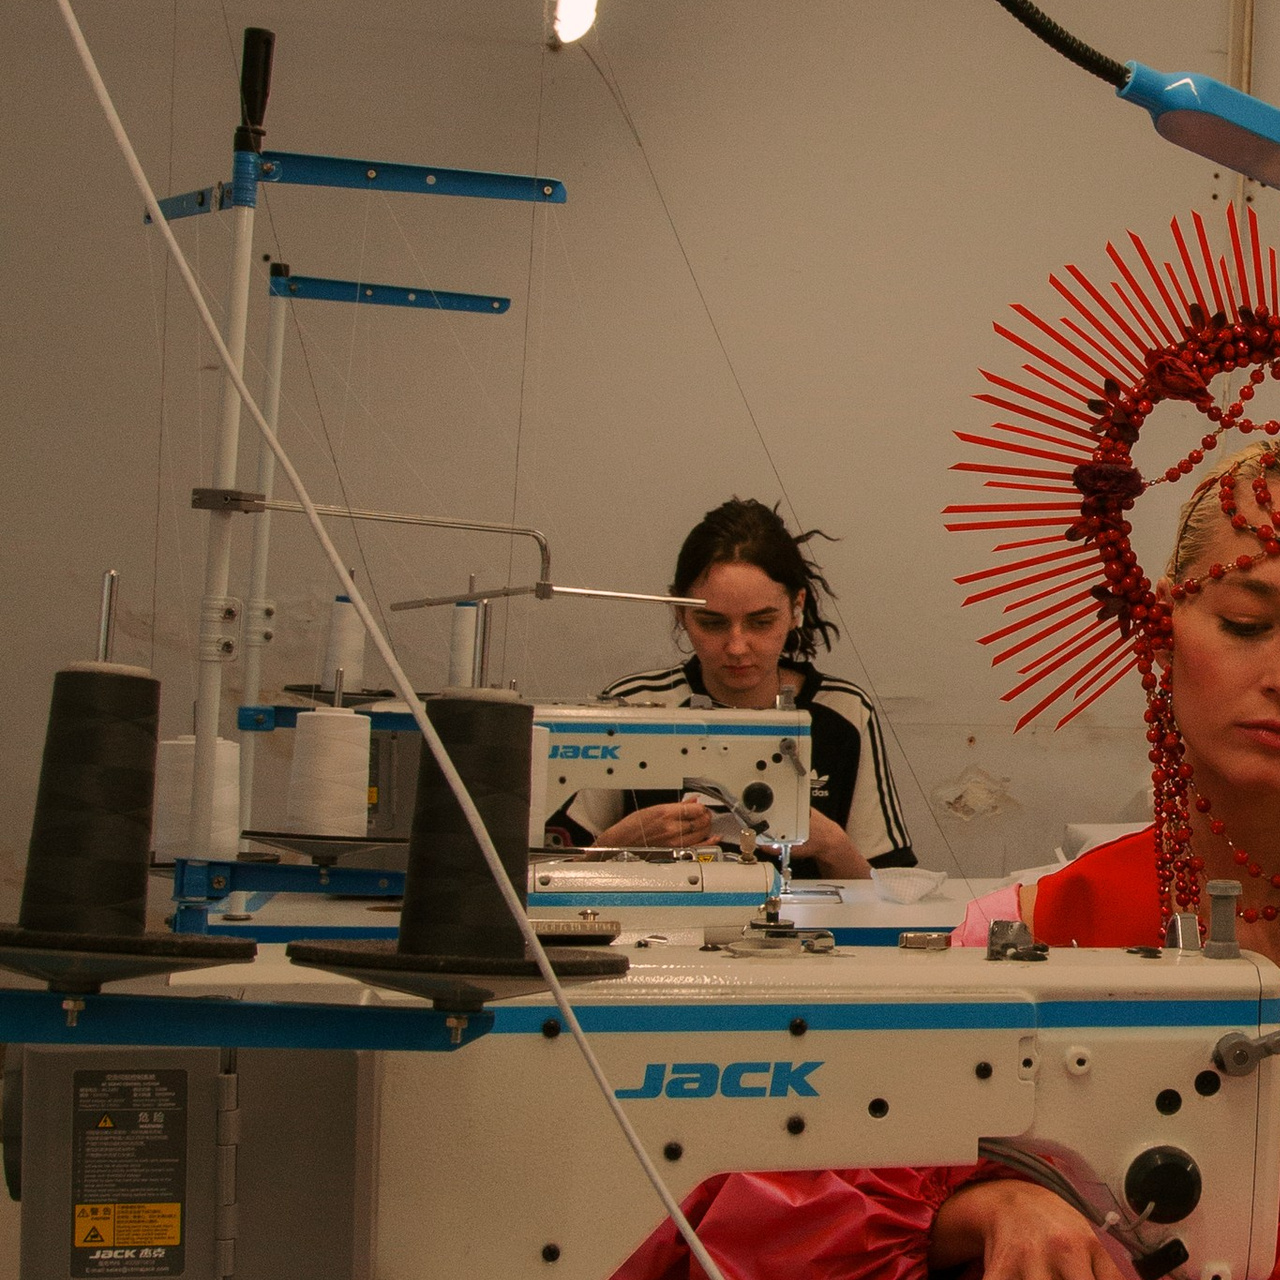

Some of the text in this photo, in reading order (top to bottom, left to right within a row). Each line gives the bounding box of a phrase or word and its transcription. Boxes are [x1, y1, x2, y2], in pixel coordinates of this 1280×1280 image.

[548, 744, 621, 759] JACK
[614, 1061, 825, 1099] JACK
[89, 1249, 137, 1259] JACK
